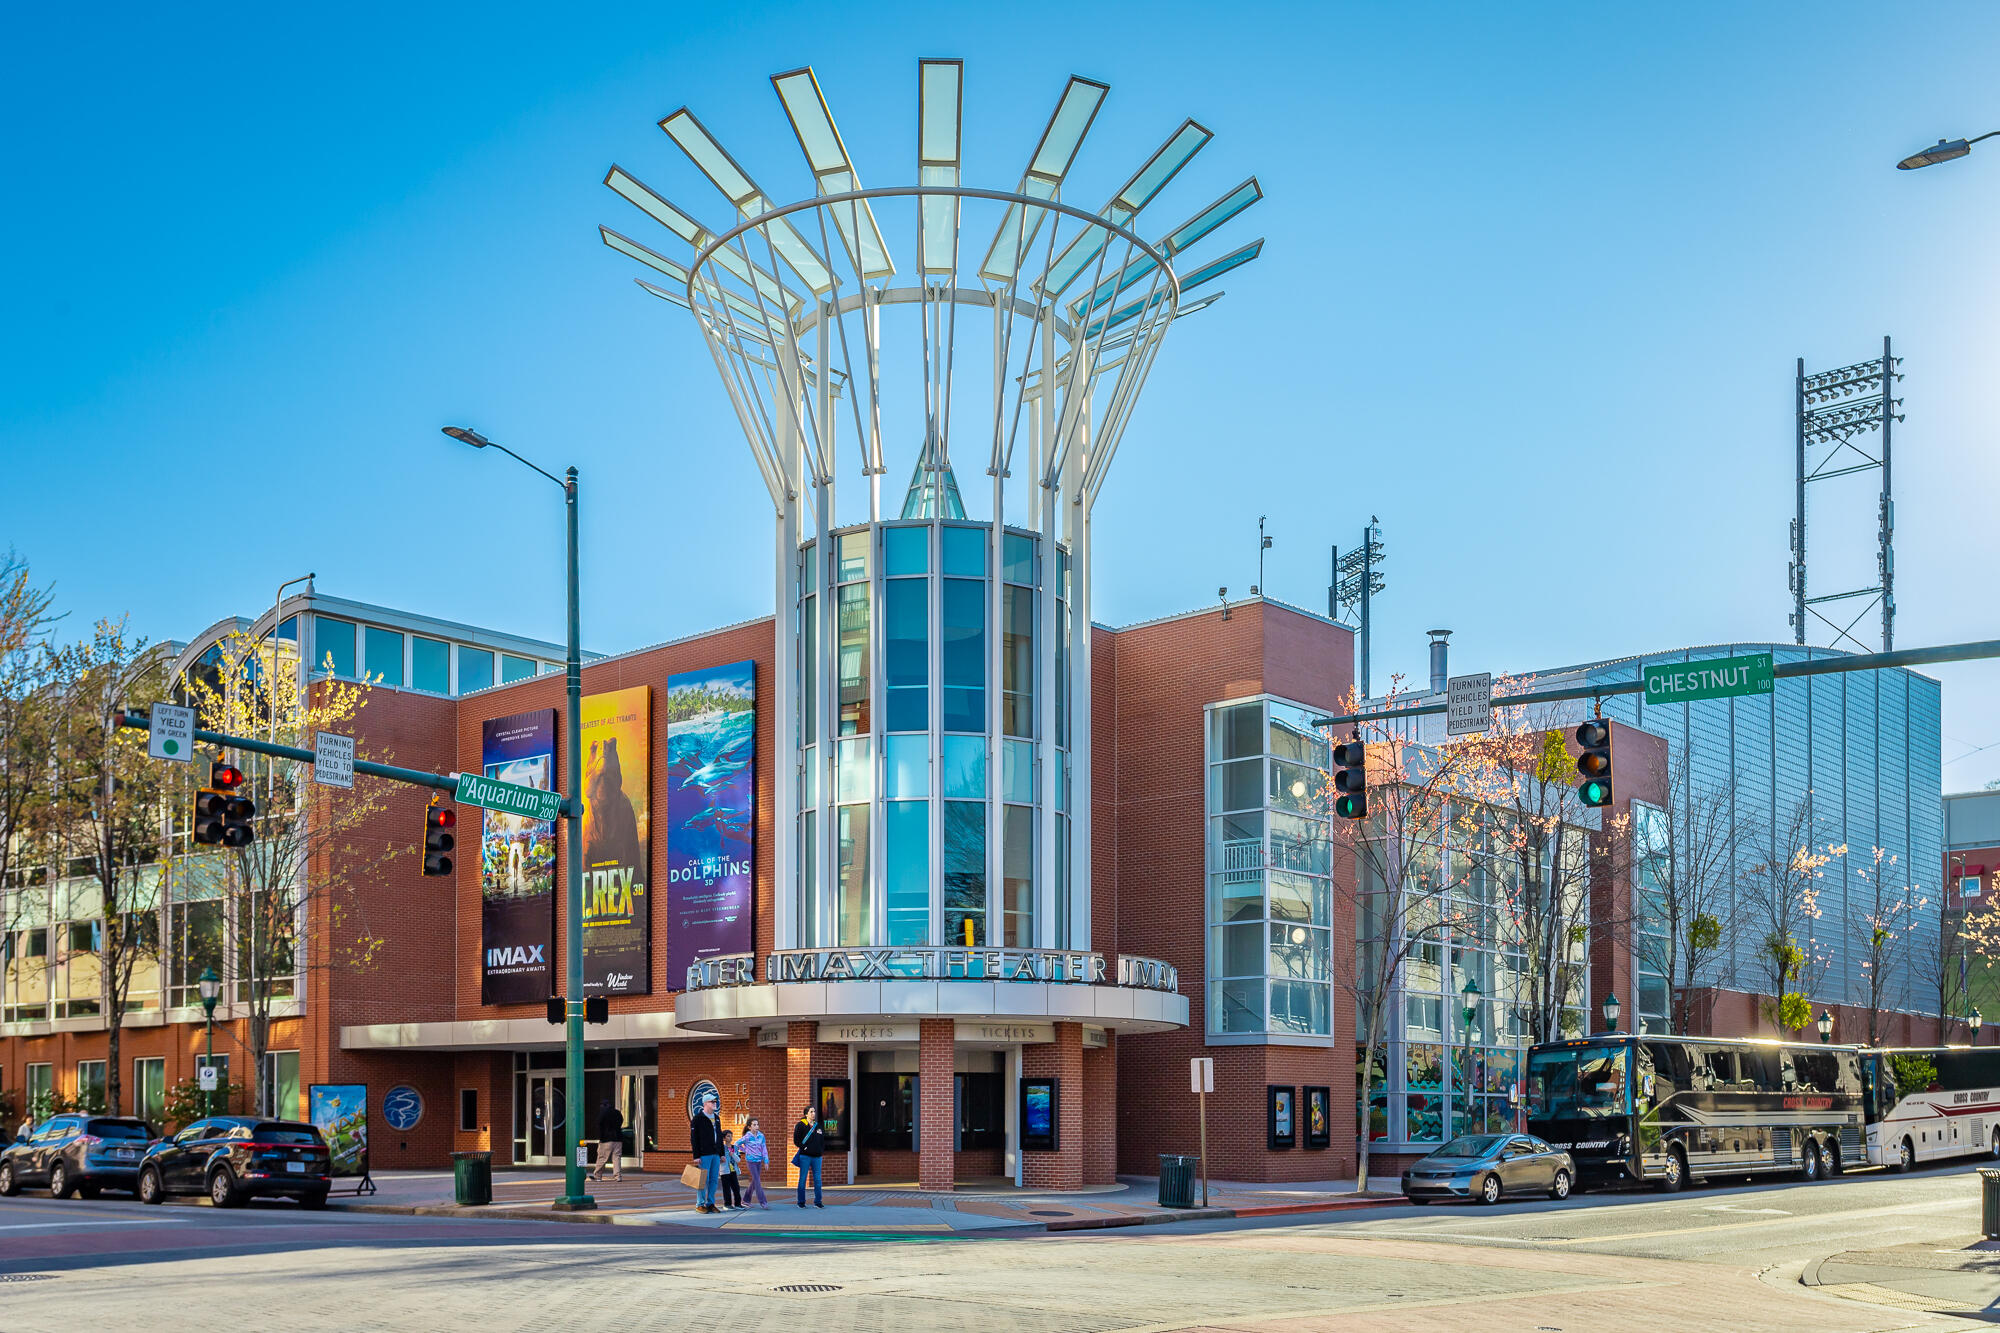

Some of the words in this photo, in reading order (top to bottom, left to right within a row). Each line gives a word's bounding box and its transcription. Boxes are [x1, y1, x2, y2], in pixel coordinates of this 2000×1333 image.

[1757, 658, 1766, 668] ST
[1451, 678, 1487, 691] TURNING
[1649, 666, 1750, 694] CHESTNUT
[1757, 679, 1771, 690] 100
[1450, 691, 1488, 704] VEHICLES
[157, 707, 172, 716] LEFT
[174, 709, 189, 718] TURN
[1450, 705, 1473, 716] YIELD
[1478, 703, 1487, 713] TO
[160, 716, 186, 729] YIELD
[1449, 717, 1488, 729] PEDESTRIANS
[157, 728, 166, 736] ON
[168, 729, 187, 738] GREEN
[319, 735, 352, 750] TURNING
[318, 747, 352, 761] VEHICLES
[318, 758, 339, 770] YIELD
[343, 761, 352, 772] TO
[315, 769, 352, 783] PEDESTRIANS
[461, 775, 471, 787] W
[465, 777, 539, 811] Aquarium
[541, 793, 560, 807] WAY
[538, 807, 555, 819] 200
[706, 856, 715, 864] OF
[670, 860, 750, 883] DOLPHINS
[704, 879, 714, 887] 3D
[633, 884, 644, 896] 3D
[487, 944, 545, 967] IMAX
[487, 968, 526, 976] EXTRAORDINARY
[526, 965, 546, 973] AWAITS
[766, 951, 894, 980] IMAX
[916, 951, 1107, 981] THEATER
[1117, 957, 1179, 993] IMAX
[839, 1027, 894, 1039] TICKETS
[981, 1026, 1035, 1039] TICKETS
[1806, 1096, 1833, 1108] COUNTRY
[1575, 1141, 1610, 1149] COUNTRY
